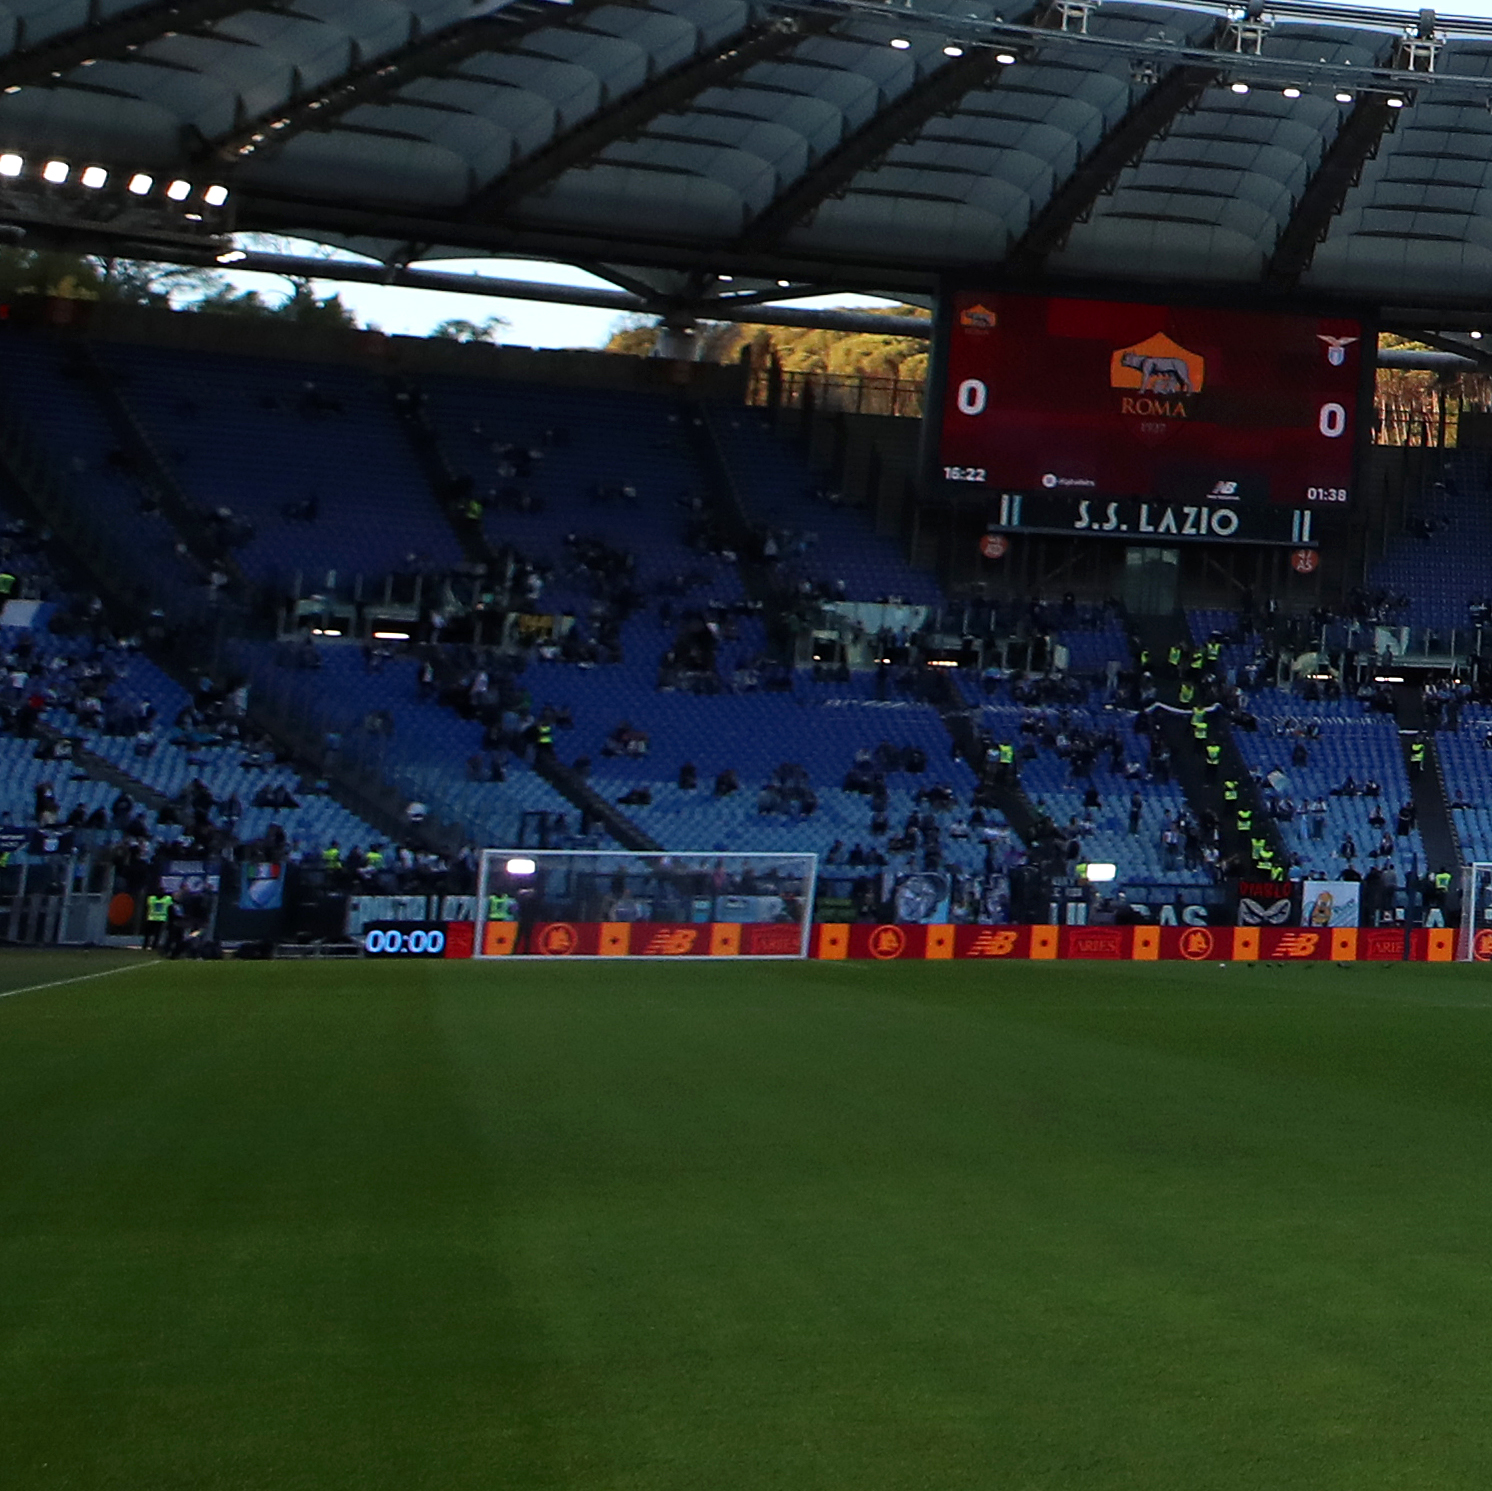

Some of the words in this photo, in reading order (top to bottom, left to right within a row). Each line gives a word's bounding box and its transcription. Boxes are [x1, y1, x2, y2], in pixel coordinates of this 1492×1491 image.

[957, 379, 987, 416] 0
[1121, 397, 1187, 419] ROMA
[1319, 402, 1347, 438] 0
[943, 466, 987, 482] 16:22
[1307, 487, 1347, 502] 01:38
[1073, 499, 1128, 531] S.S.
[1138, 503, 1240, 537] LAZIO
[365, 929, 445, 953] 00:00
[1375, 938, 1404, 953] ARIE
